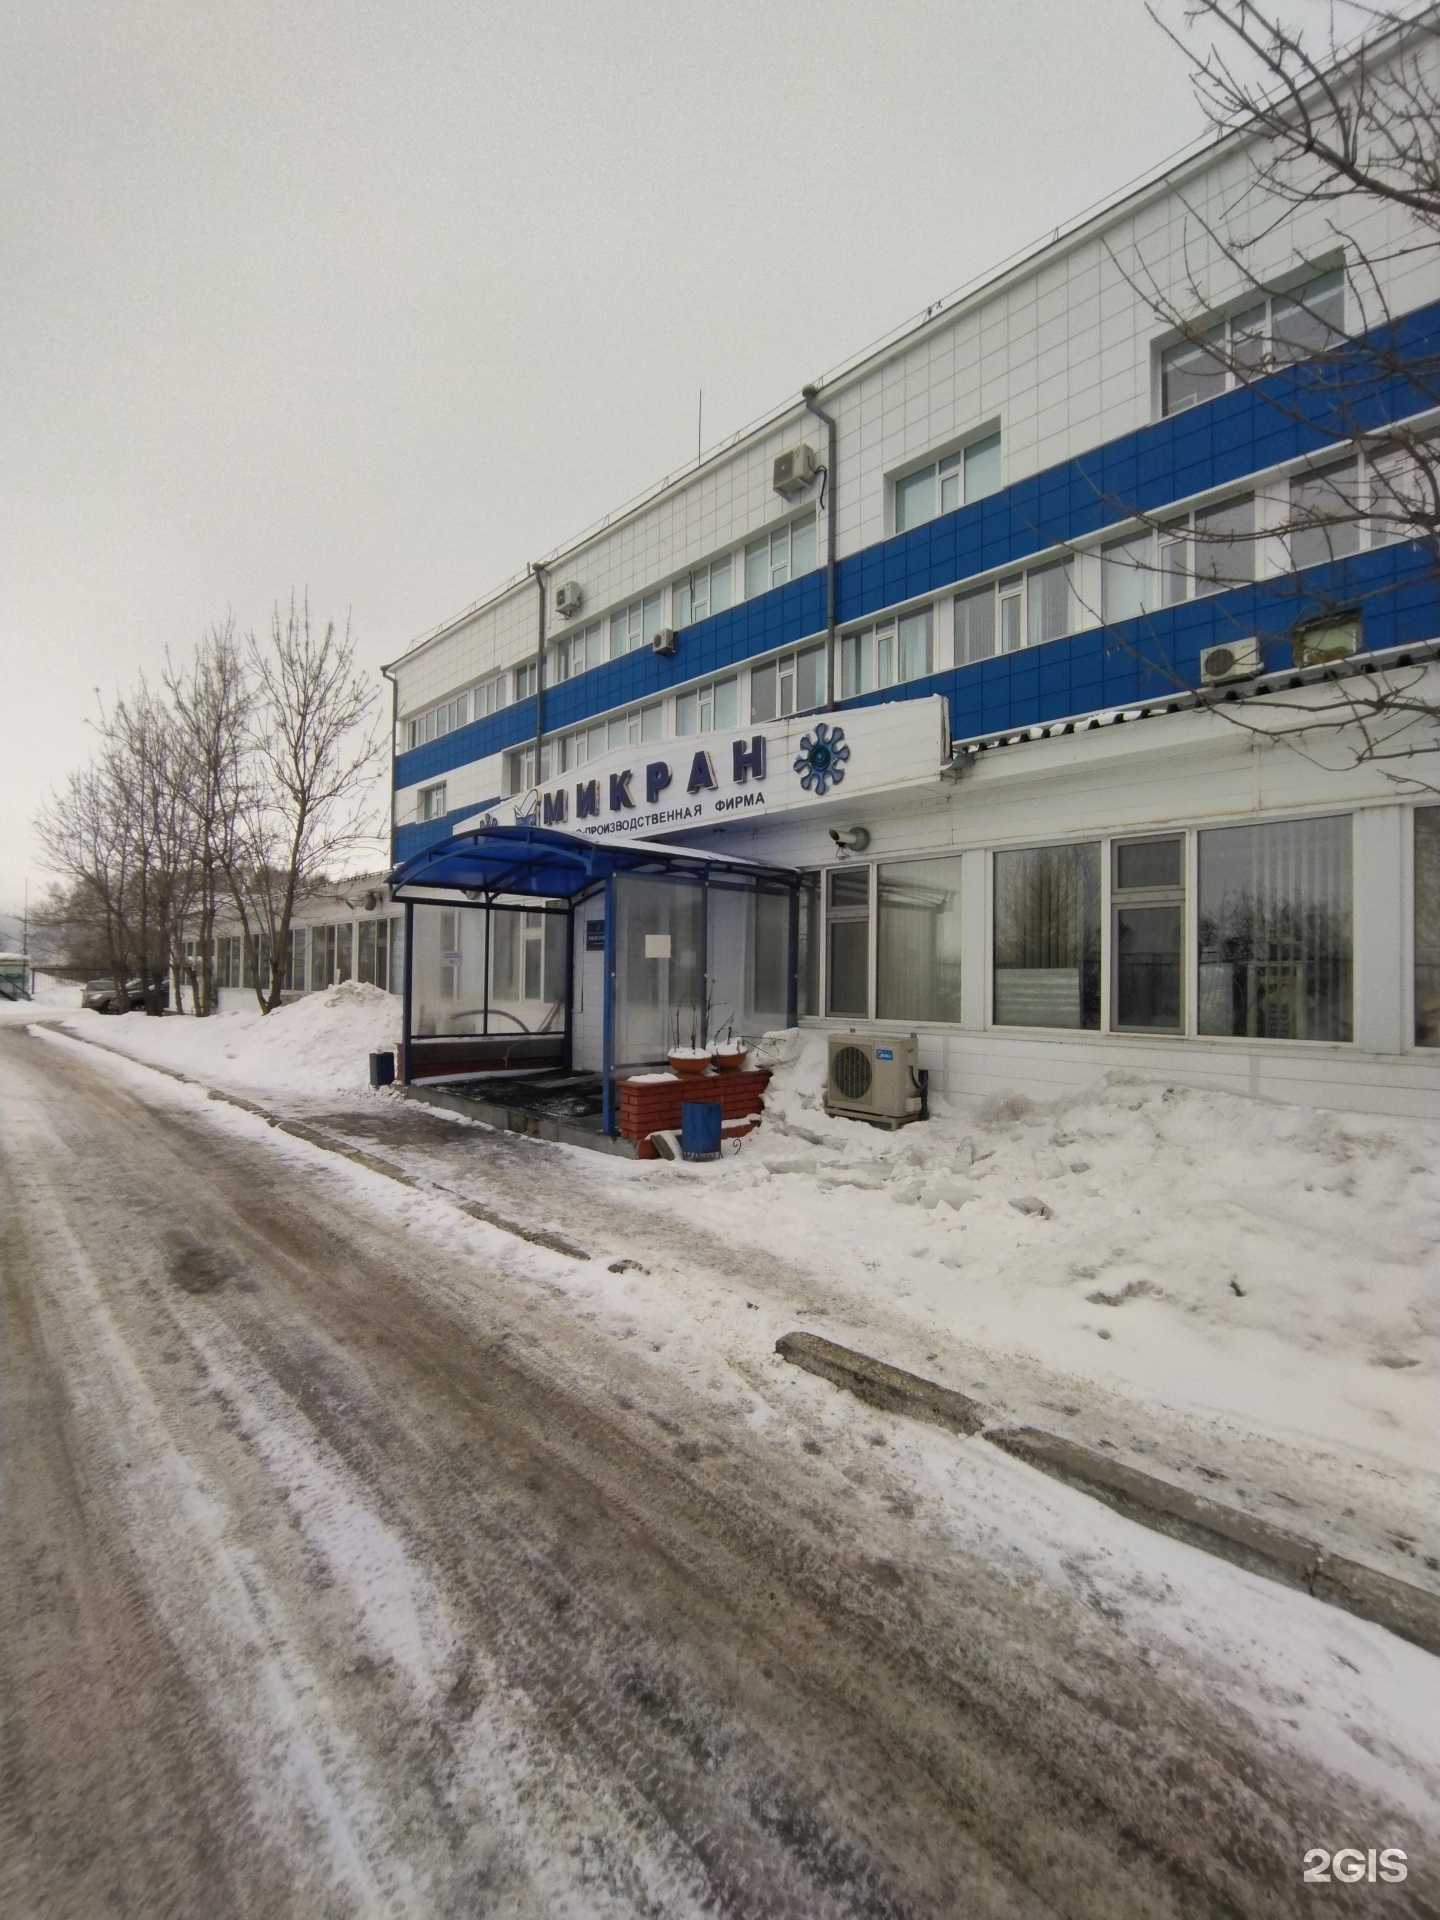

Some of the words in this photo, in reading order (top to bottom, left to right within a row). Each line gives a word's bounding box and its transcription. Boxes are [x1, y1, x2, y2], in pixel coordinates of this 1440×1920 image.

[544, 735, 767, 826] МИКРАН
[576, 804, 702, 836] -ПРОИЗВОДСТВЕННАЯ
[715, 792, 765, 812] ФИРМА
